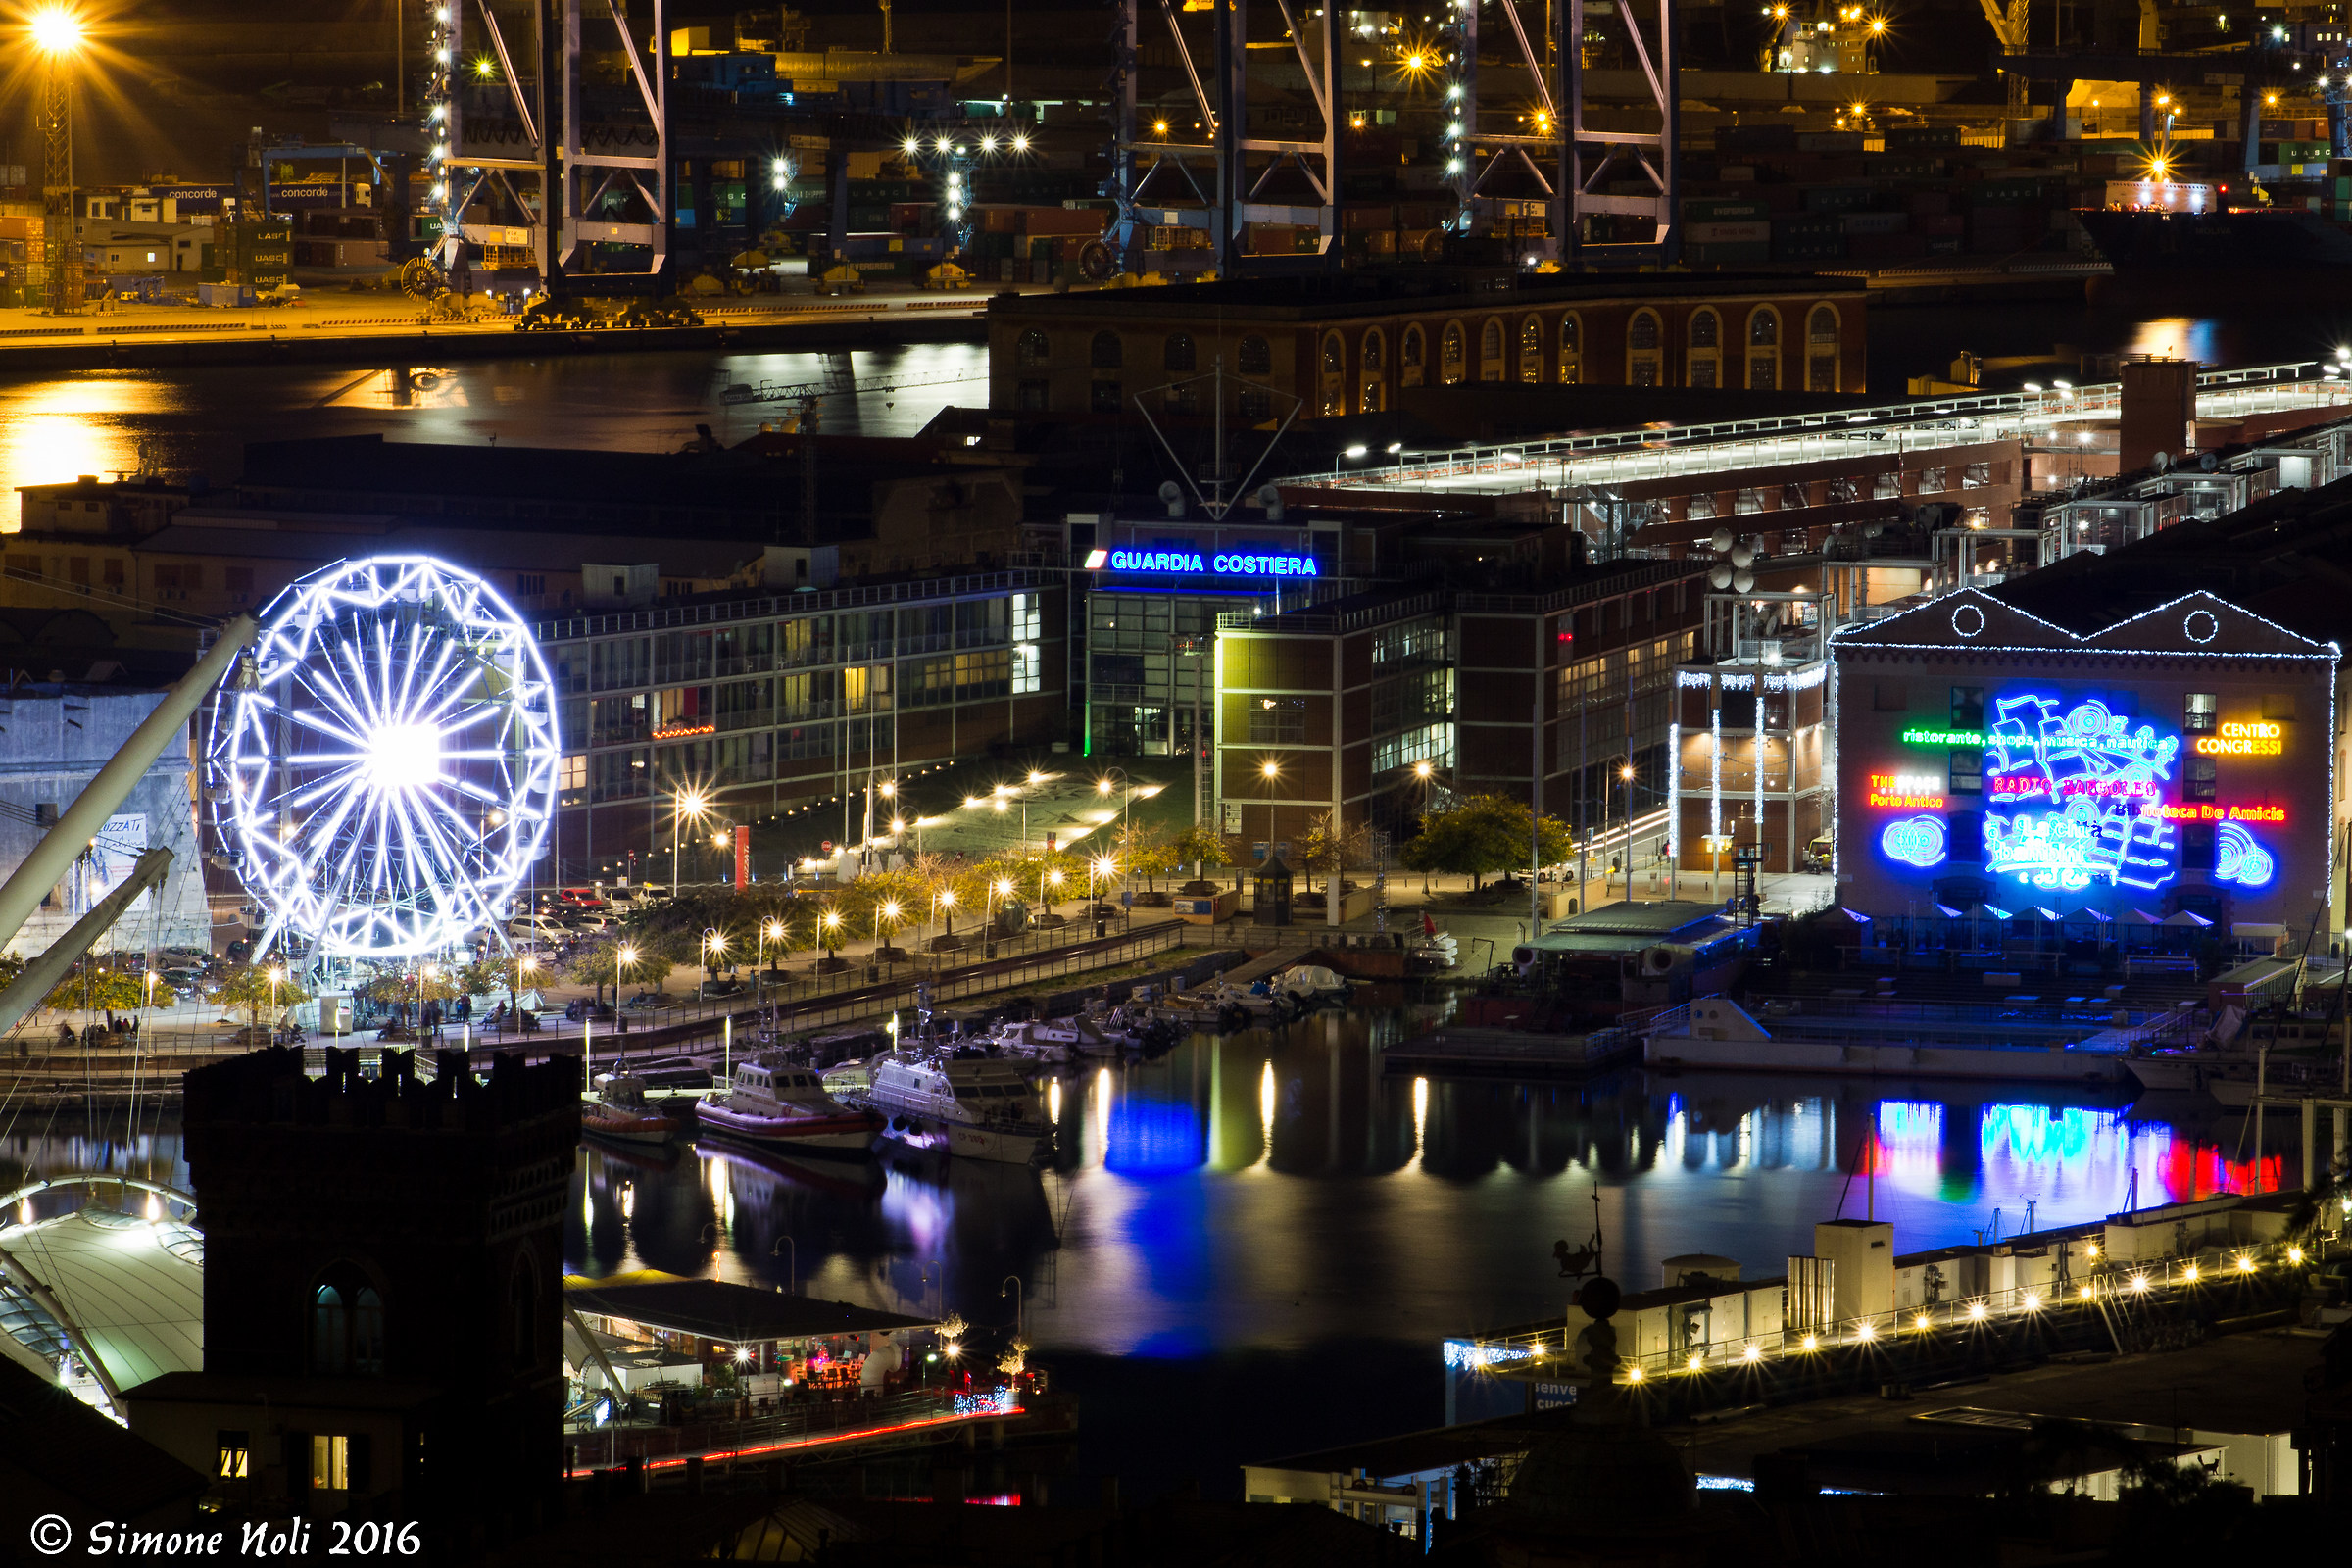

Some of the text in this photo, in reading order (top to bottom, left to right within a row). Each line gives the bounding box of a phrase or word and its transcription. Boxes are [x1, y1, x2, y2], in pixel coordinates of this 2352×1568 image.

[170, 188, 217, 199] concorde
[281, 187, 328, 198] concorde
[1111, 551, 1317, 575] GUARDIA COSTIERA
[1902, 728, 1985, 747] ristorante,
[2106, 735, 2168, 750] nautica
[2221, 722, 2280, 739] CENTRO
[2196, 737, 2281, 755] CONGRESSI
[1871, 774, 1895, 788] THE
[1992, 776, 2052, 795] RADIO
[1870, 793, 1943, 808] Porto Antico
[2115, 804, 2285, 821] Biblioteca De Amicis
